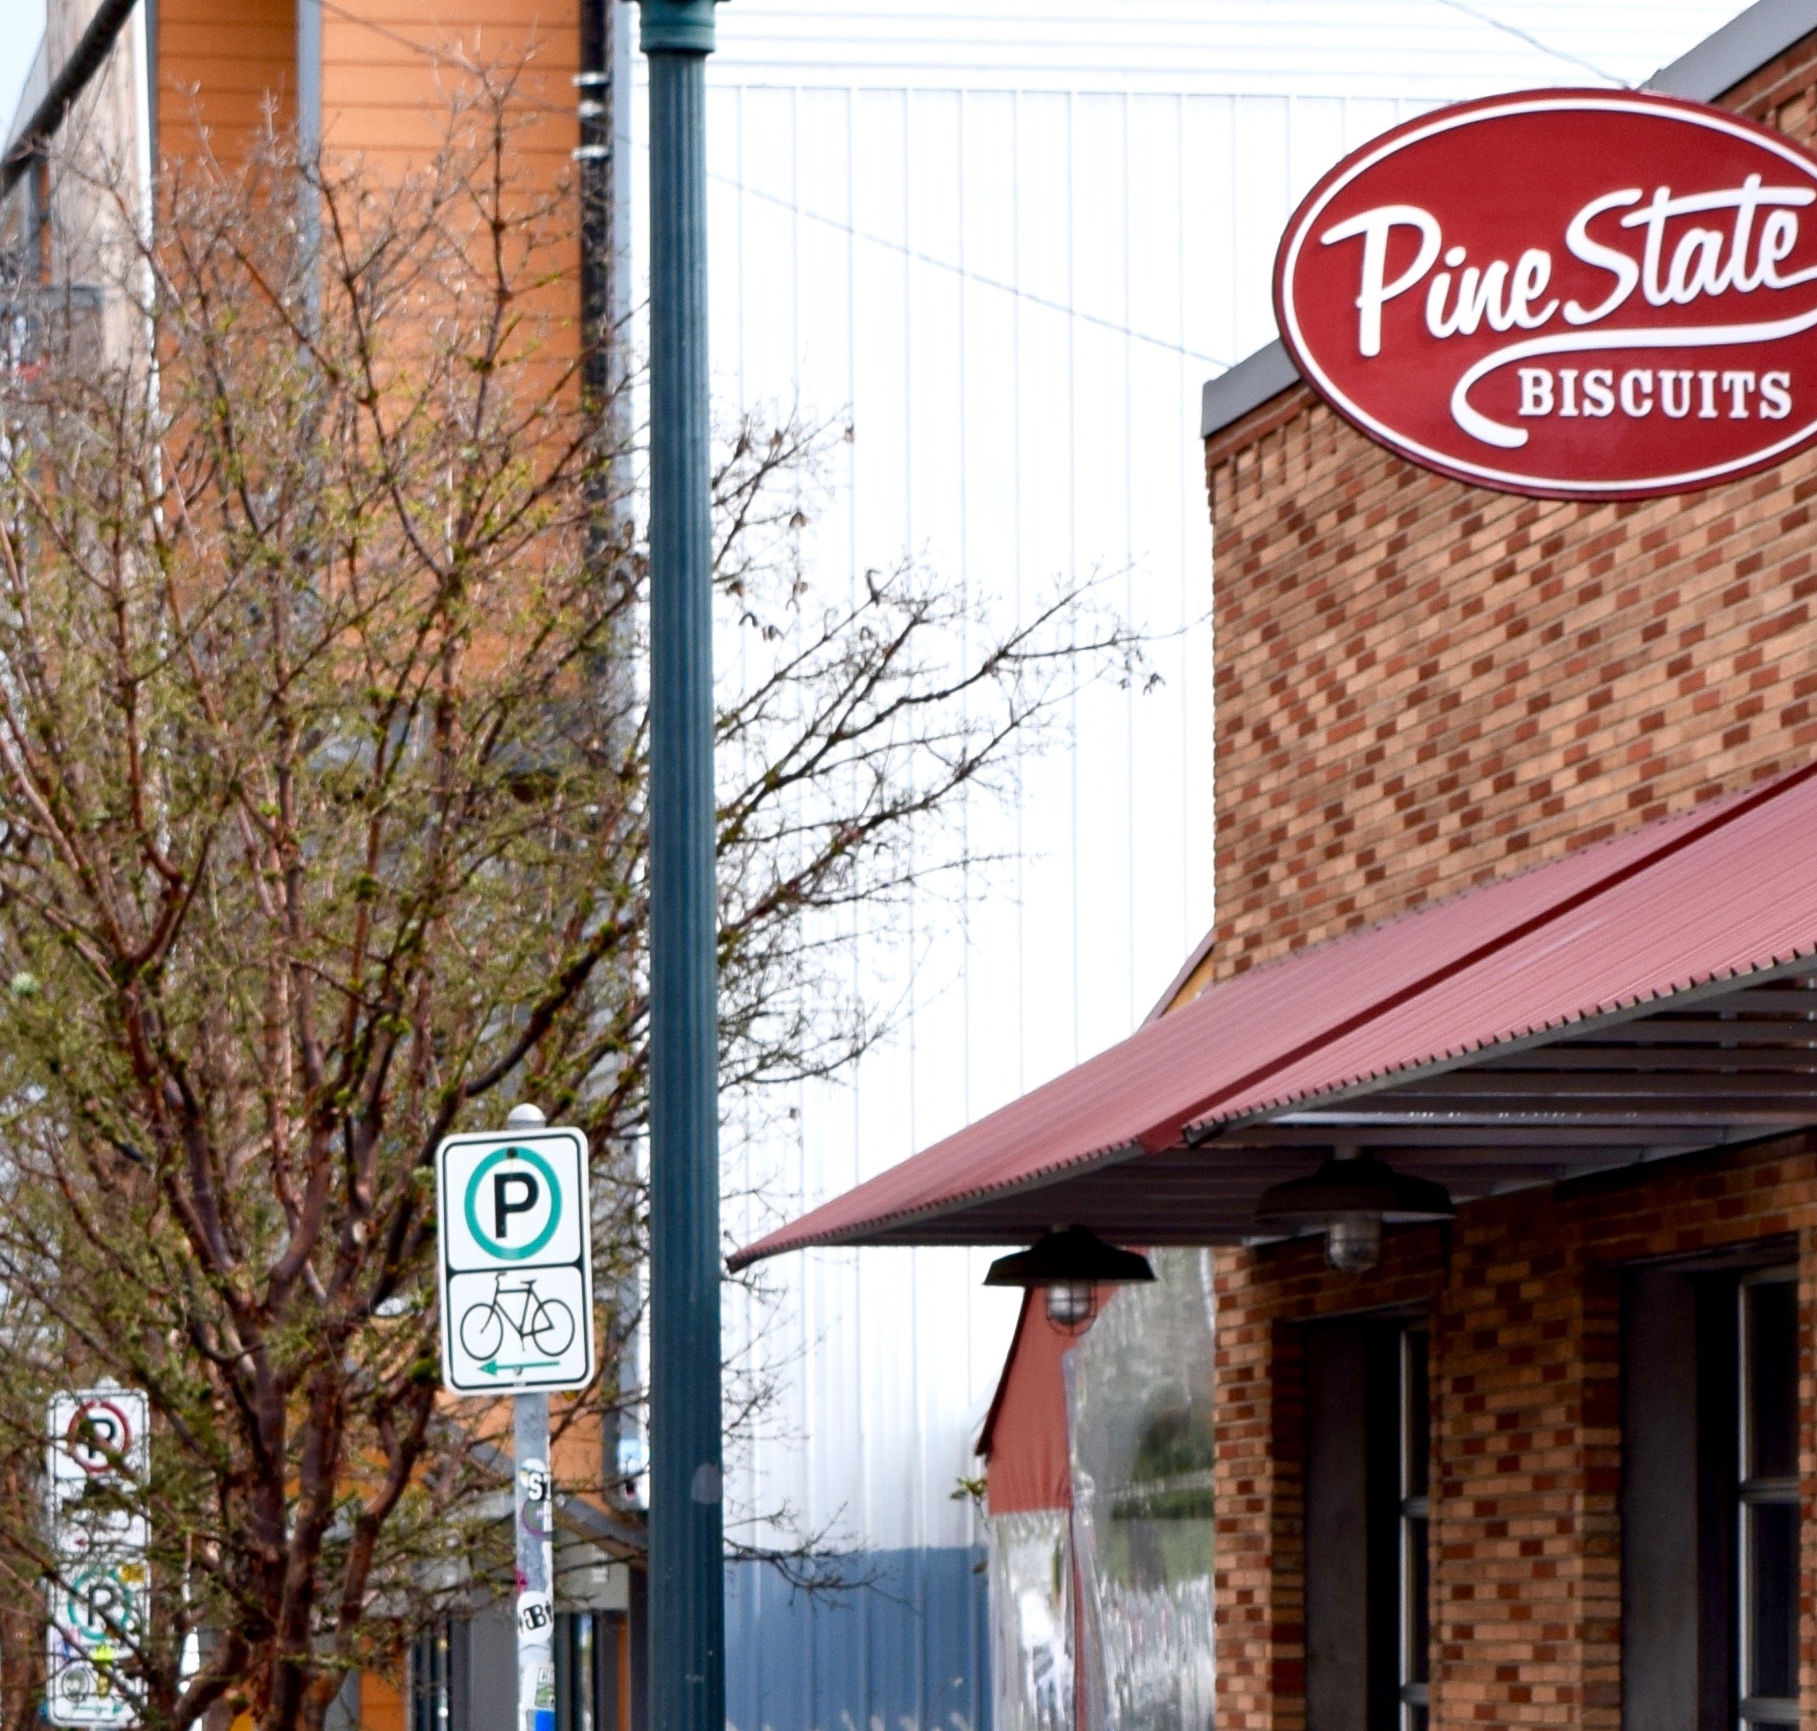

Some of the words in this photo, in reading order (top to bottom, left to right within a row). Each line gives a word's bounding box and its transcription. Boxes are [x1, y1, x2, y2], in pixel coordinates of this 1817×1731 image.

[1321, 204, 1560, 357] Pine
[1517, 368, 1793, 419] BISCUITS
[494, 1172, 540, 1239] P
